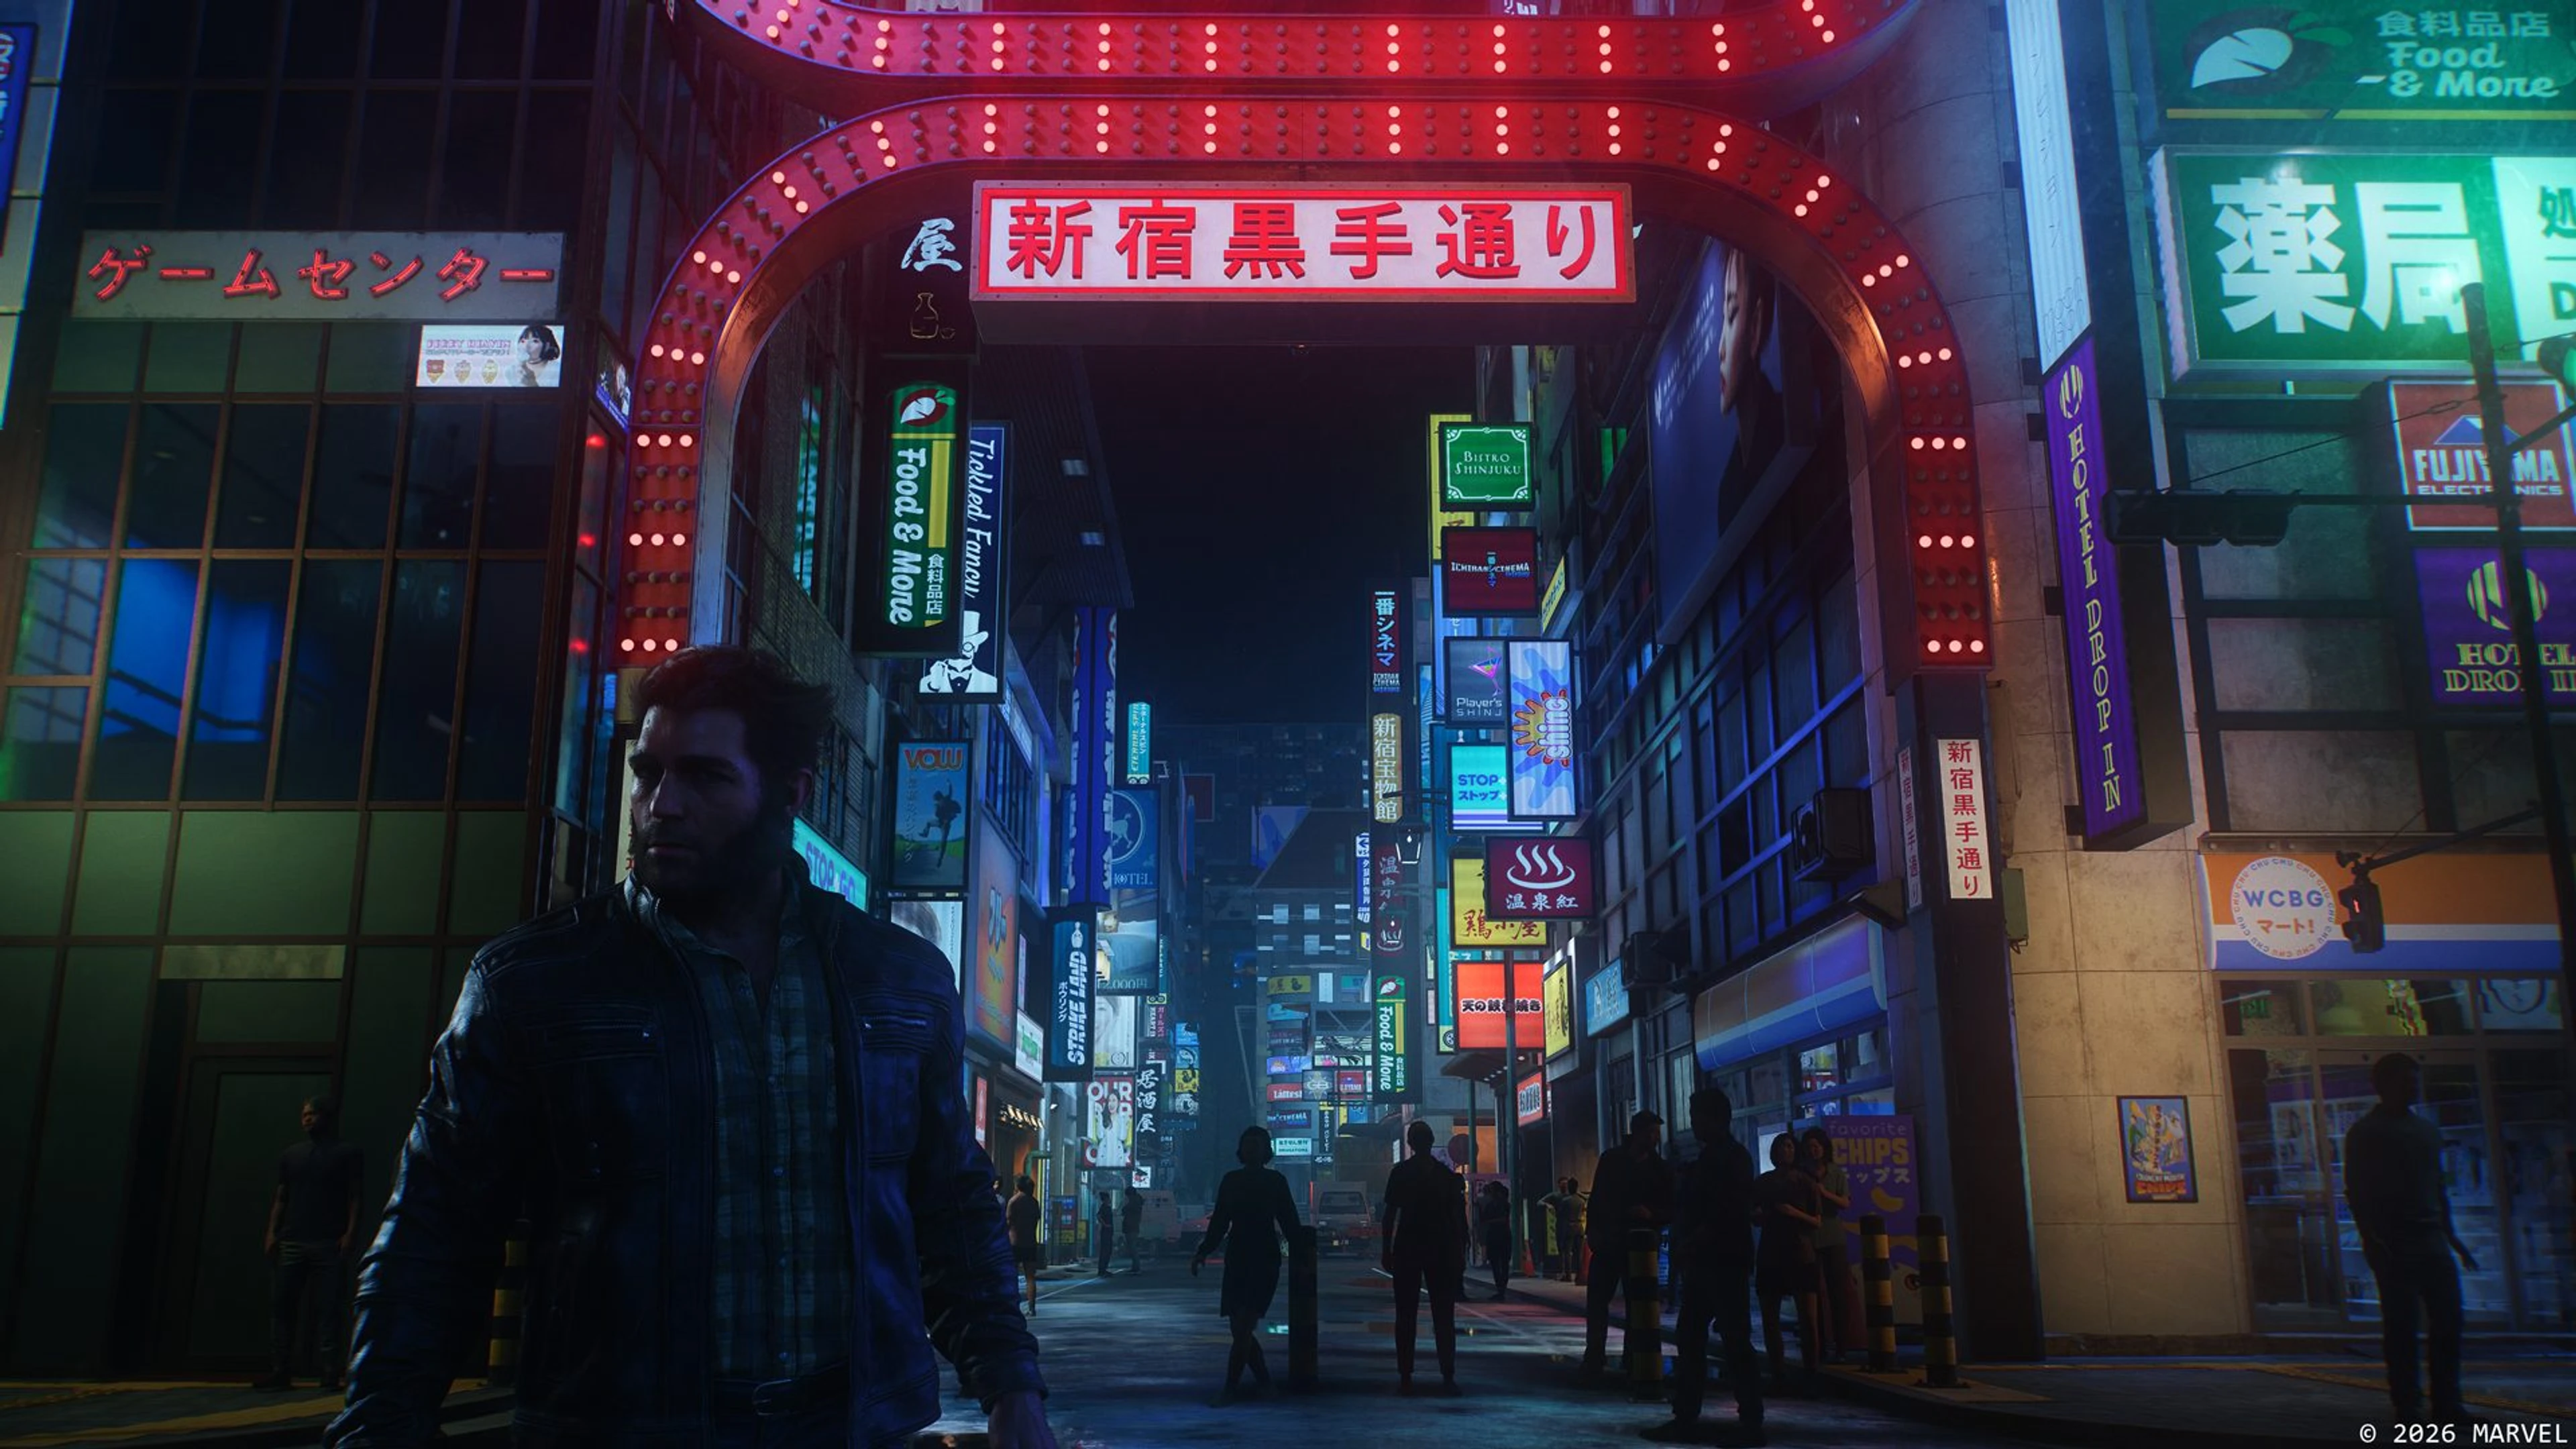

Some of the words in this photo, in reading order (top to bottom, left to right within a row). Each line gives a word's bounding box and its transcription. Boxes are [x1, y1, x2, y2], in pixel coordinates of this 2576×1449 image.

[2376, 11, 2550, 37] 食料品店
[2387, 41, 2506, 68] Food
[2388, 70, 2422, 97] &
[2435, 70, 2561, 97] More
[901, 218, 963, 272] 屋
[1006, 197, 1597, 280] 新宿黒手通り
[2211, 176, 2483, 335] 薬局
[88, 244, 555, 302] ゲームセンター
[896, 448, 926, 516] Food
[966, 439, 995, 523] Tickled
[2413, 449, 2560, 482] FUJIYMA
[2417, 485, 2563, 495] ELECTNICS
[893, 523, 924, 543] &
[890, 550, 922, 625] More
[926, 553, 944, 614] 食料品店
[1375, 592, 1395, 666] 一番シネマ
[2068, 423, 2100, 588] HOTEL
[2086, 598, 2112, 733] DROP
[2102, 742, 2121, 812] IN
[2443, 669, 2526, 692] DRO
[1456, 697, 1502, 708] Player's
[1375, 717, 1395, 820] 新宿宝物館
[1458, 774, 1498, 786] STOP
[1458, 790, 1499, 800] ストップ
[1947, 741, 1982, 896] 新宿黒手通り
[1505, 894, 1578, 910] 温泉紅
[2243, 890, 2324, 907] WCBG
[1070, 951, 1087, 998] LAND
[1068, 1000, 1086, 1065] STRIKE
[1379, 1006, 1393, 1041] Food
[1136, 1069, 1159, 1132] 居酒屋
[1829, 1120, 1906, 1136] favorite
[1831, 1138, 1909, 1166] CHIPS
